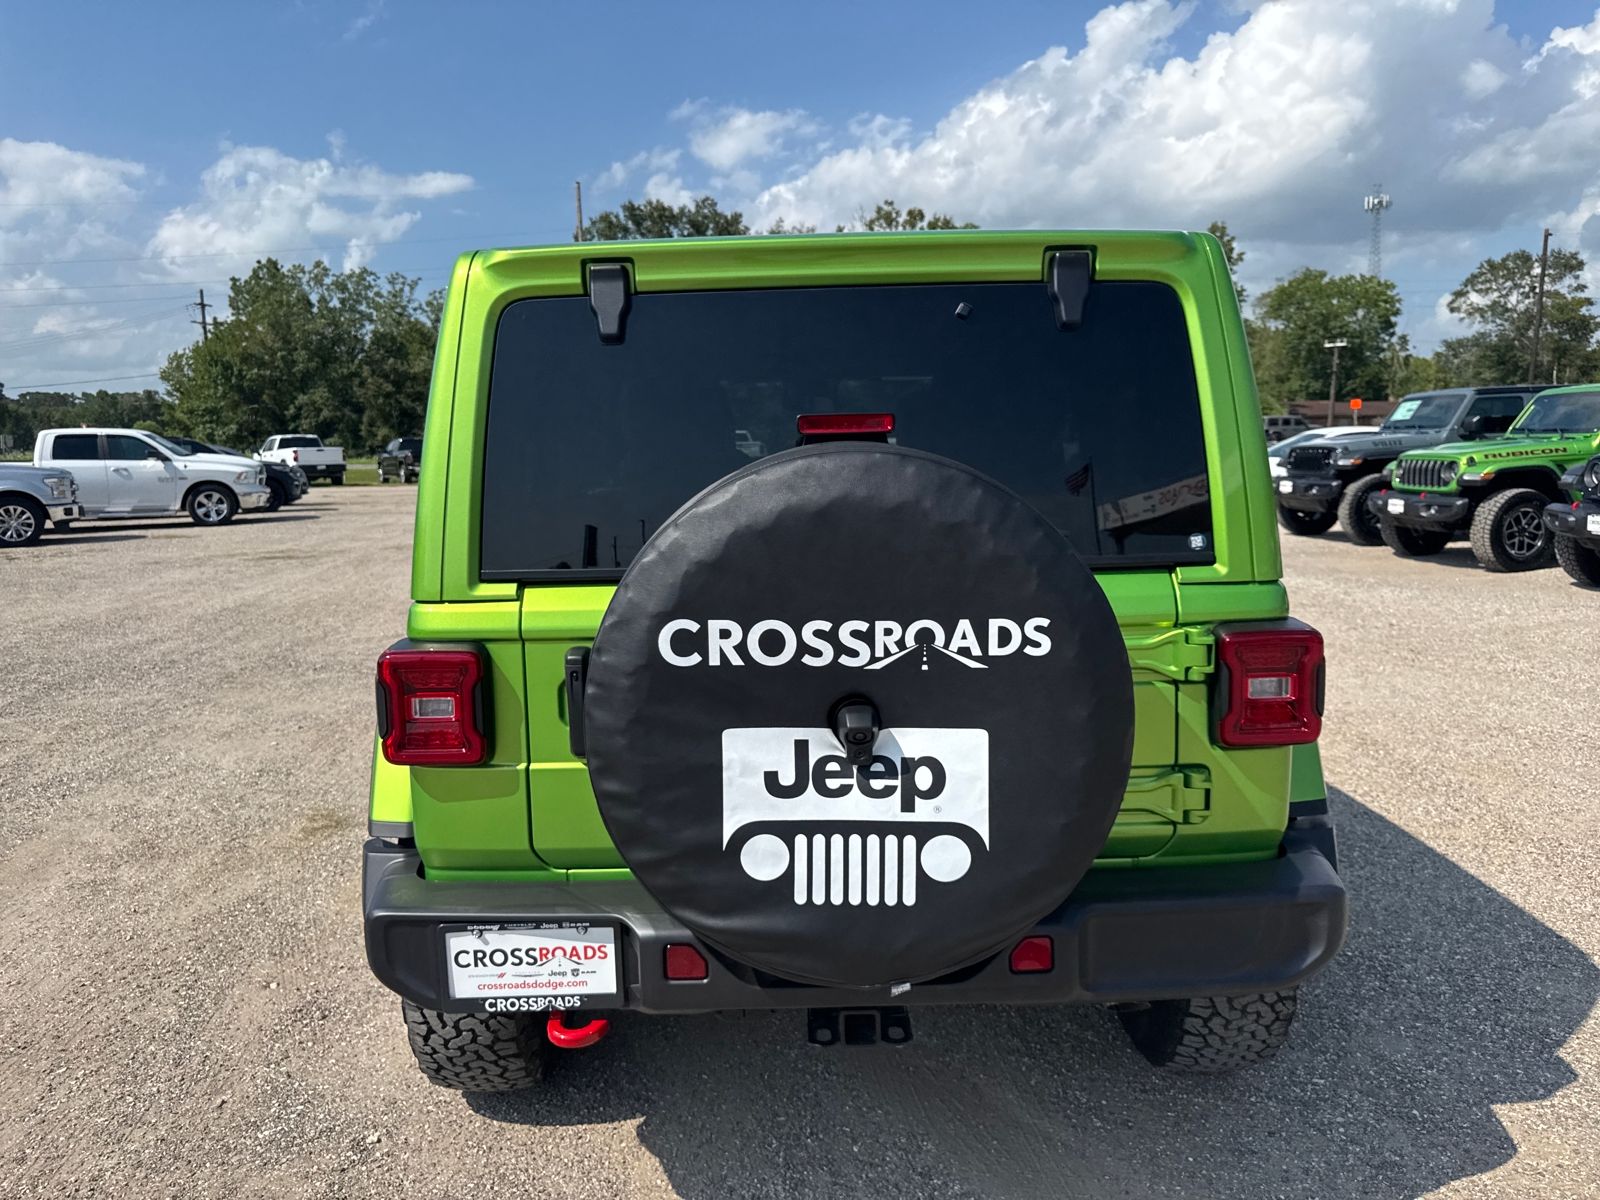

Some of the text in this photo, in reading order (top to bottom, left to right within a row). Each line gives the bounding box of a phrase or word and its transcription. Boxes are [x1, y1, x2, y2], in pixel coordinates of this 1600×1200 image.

[1483, 447, 1568, 459] RUBICON
[657, 617, 1052, 668] CROSSROADS
[763, 739, 947, 813] Jeep
[453, 944, 609, 969] CROSSROADS
[477, 980, 588, 991] crossroadsdodge.com
[485, 996, 581, 1012] CROSSROADS
